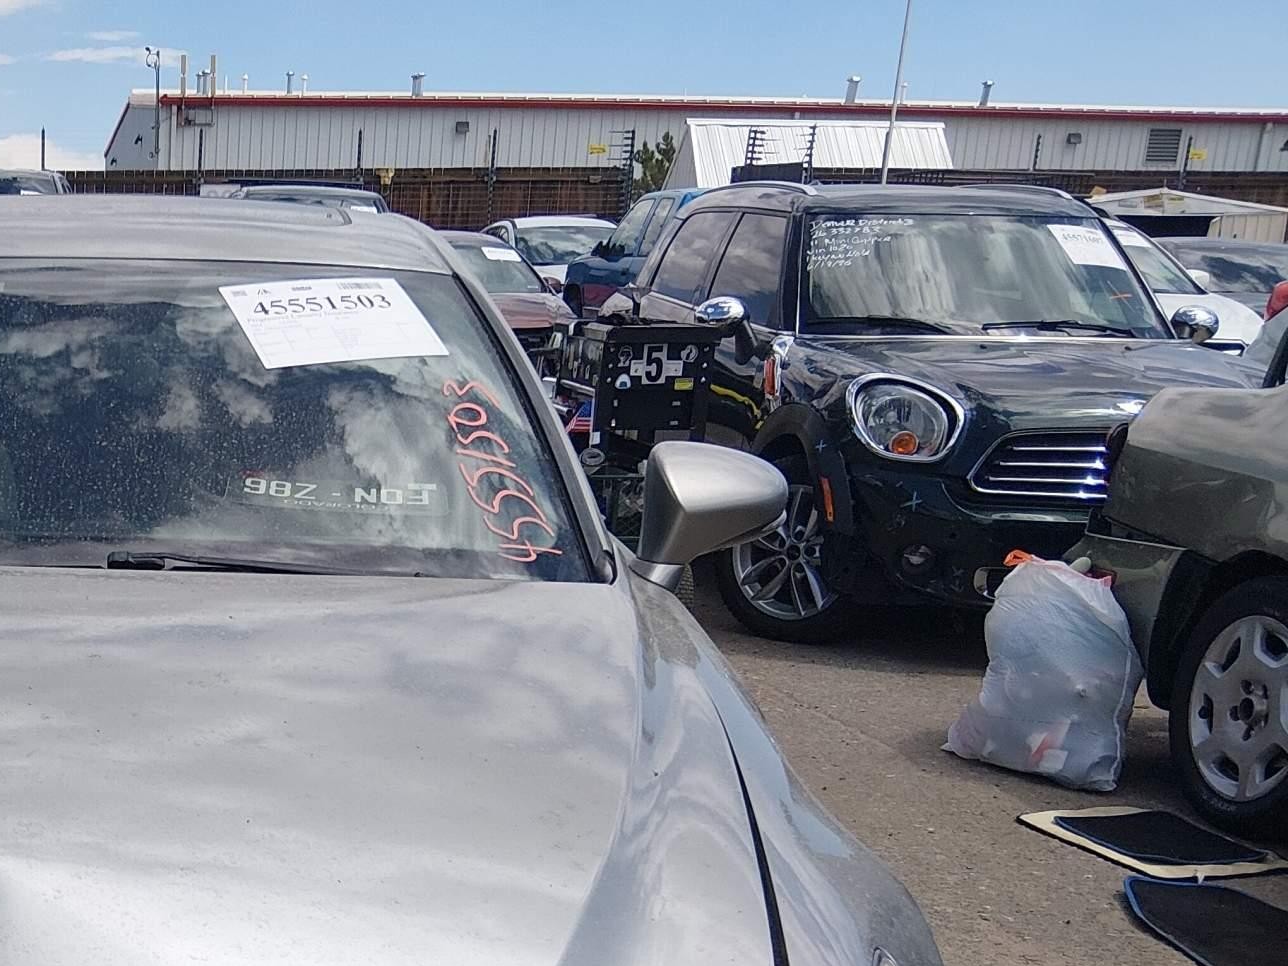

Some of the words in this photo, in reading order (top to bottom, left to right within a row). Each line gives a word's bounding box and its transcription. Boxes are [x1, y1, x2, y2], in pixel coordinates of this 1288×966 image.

[253, 294, 392, 315] 45551503
[645, 344, 664, 383] 5
[443, 380, 562, 562] 45551503
